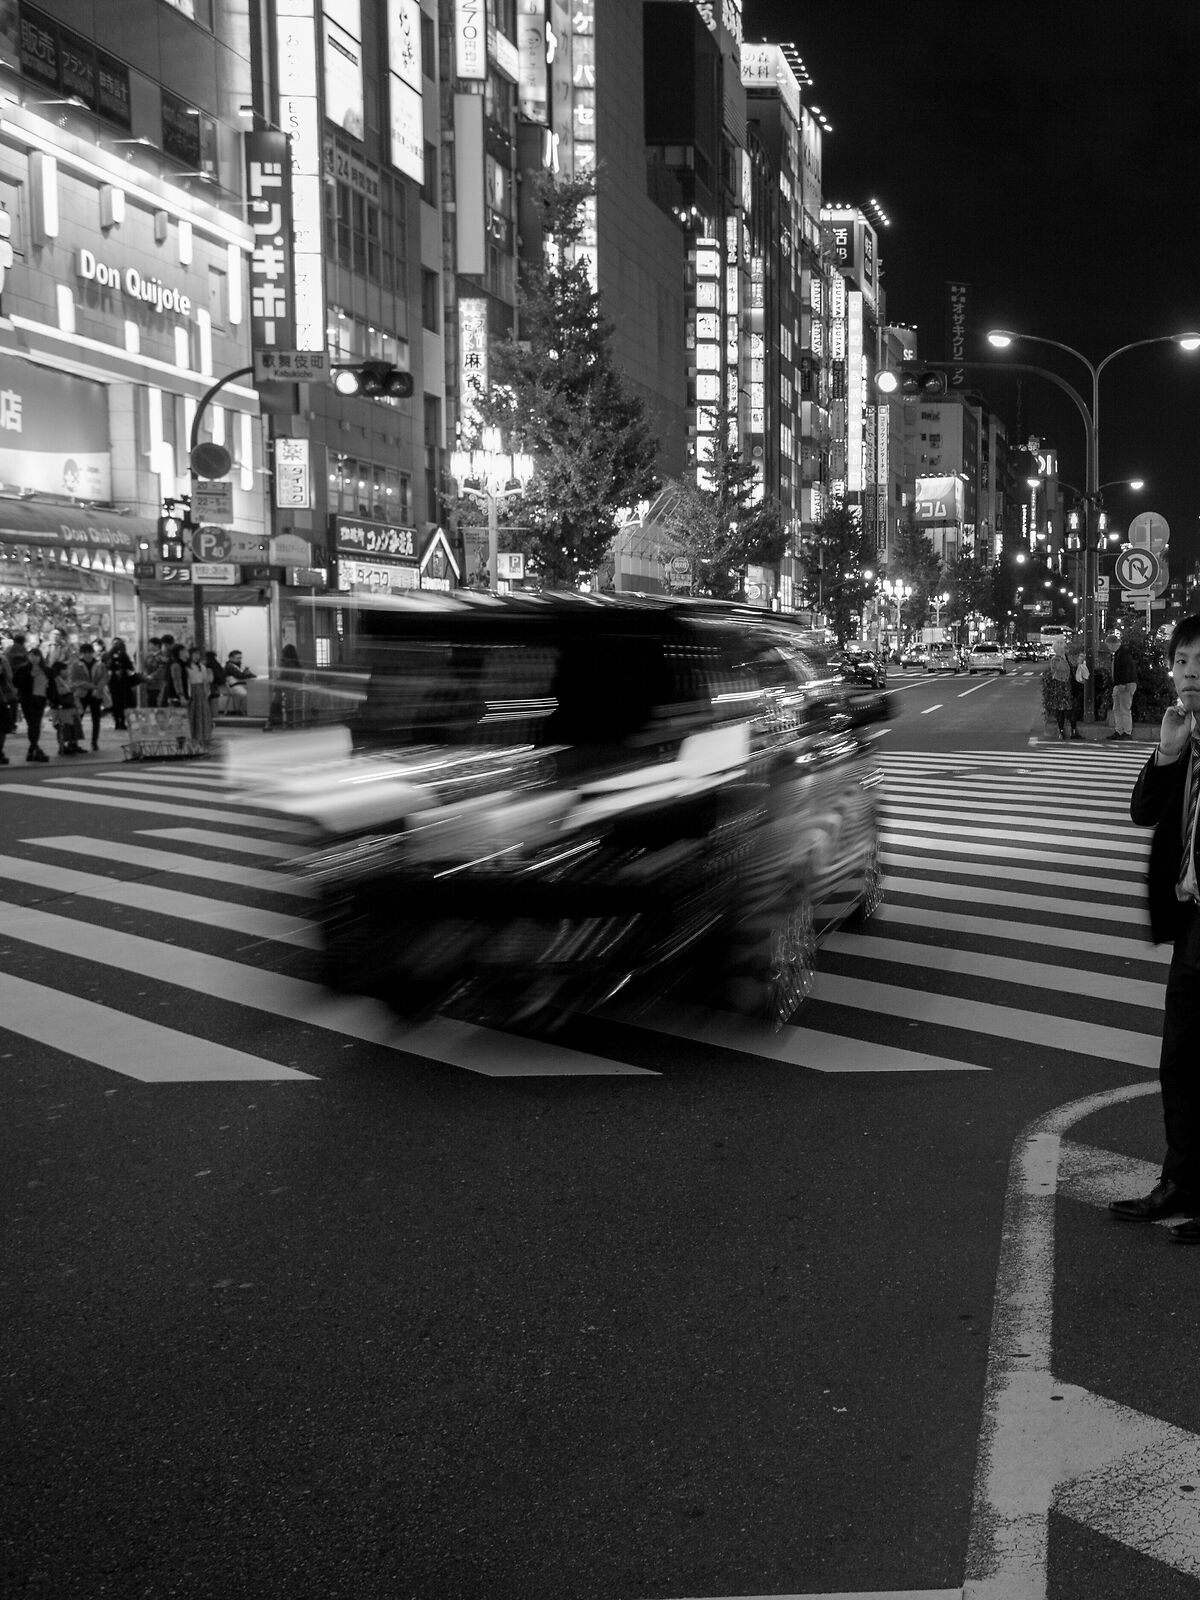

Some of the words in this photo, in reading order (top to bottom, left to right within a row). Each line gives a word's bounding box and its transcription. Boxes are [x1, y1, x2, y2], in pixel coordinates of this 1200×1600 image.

[79, 248, 121, 290] Don
[125, 267, 191, 317] Quijote
[262, 354, 325, 370] 歌舞伎町
[273, 368, 314, 379] Kabukicho
[915, 500, 948, 518] コム
[60, 524, 88, 543] Don
[200, 534, 217, 558] P
